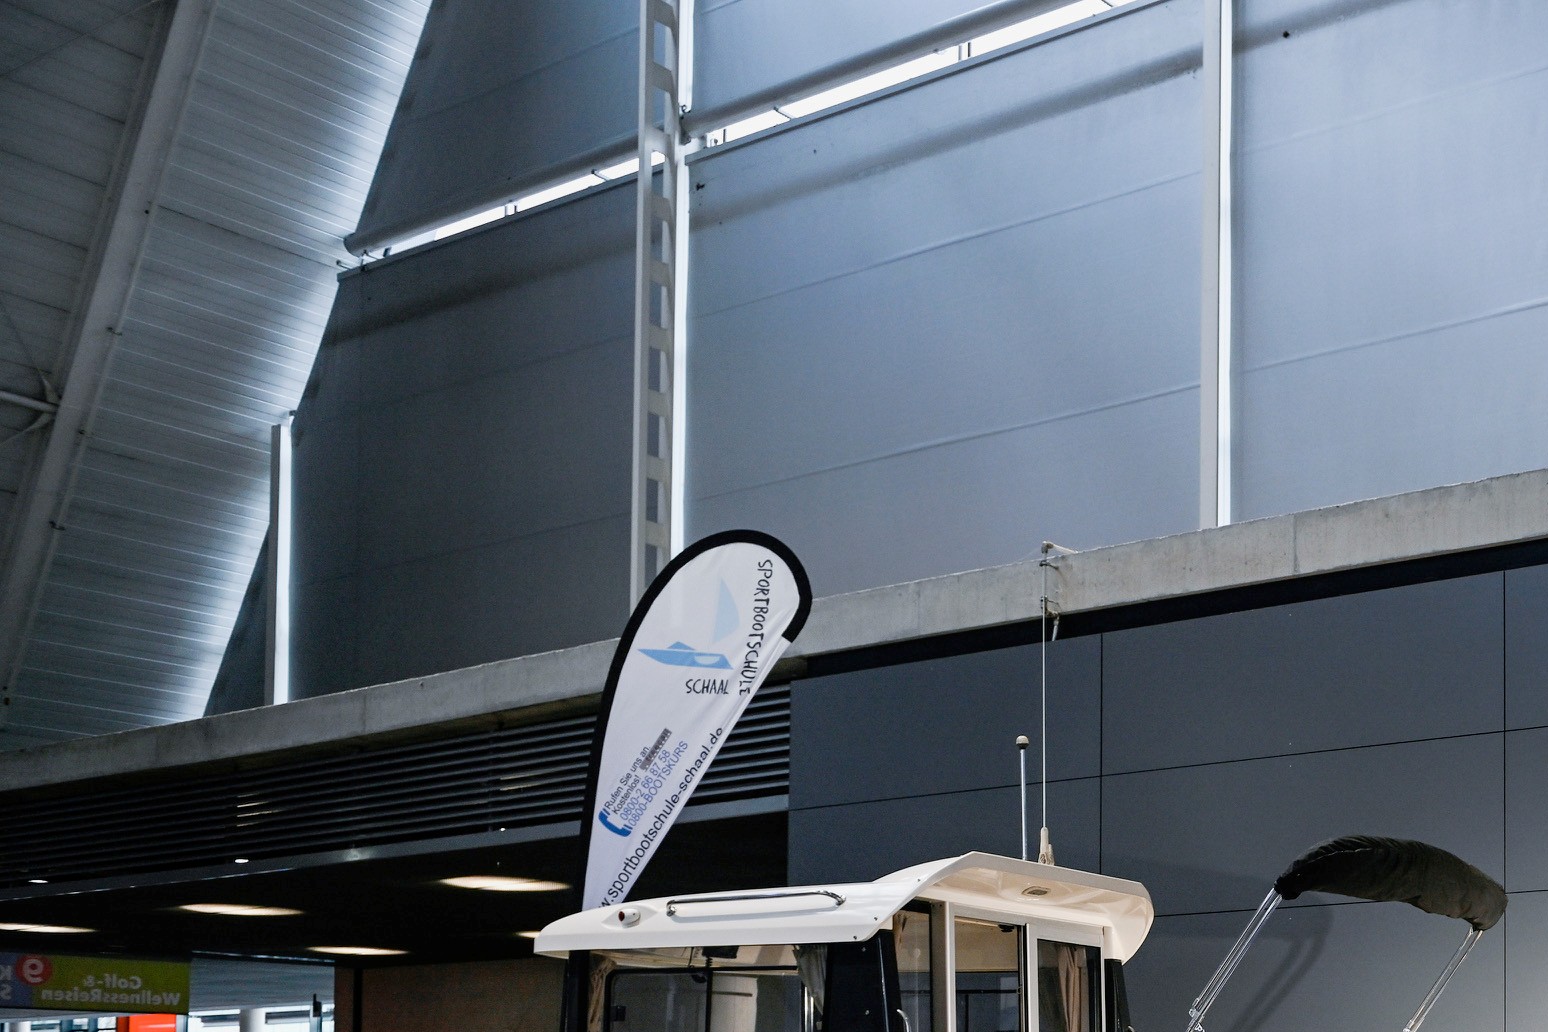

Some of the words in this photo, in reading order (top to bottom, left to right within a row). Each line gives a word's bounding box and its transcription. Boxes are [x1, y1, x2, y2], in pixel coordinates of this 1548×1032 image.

[739, 559, 773, 696] SPORTBOOTSCHULE
[685, 678, 729, 695] SCHAAL
[605, 785, 623, 810] Rufen
[619, 772, 632, 786] Sie
[630, 757, 643, 772] uns
[612, 774, 642, 815] Kostenlos!
[619, 787, 645, 821] 0800-2
[641, 775, 653, 789] 66
[650, 762, 661, 777] 87
[658, 749, 671, 762] 58
[628, 740, 688, 827] 0800-BOOTSKURS
